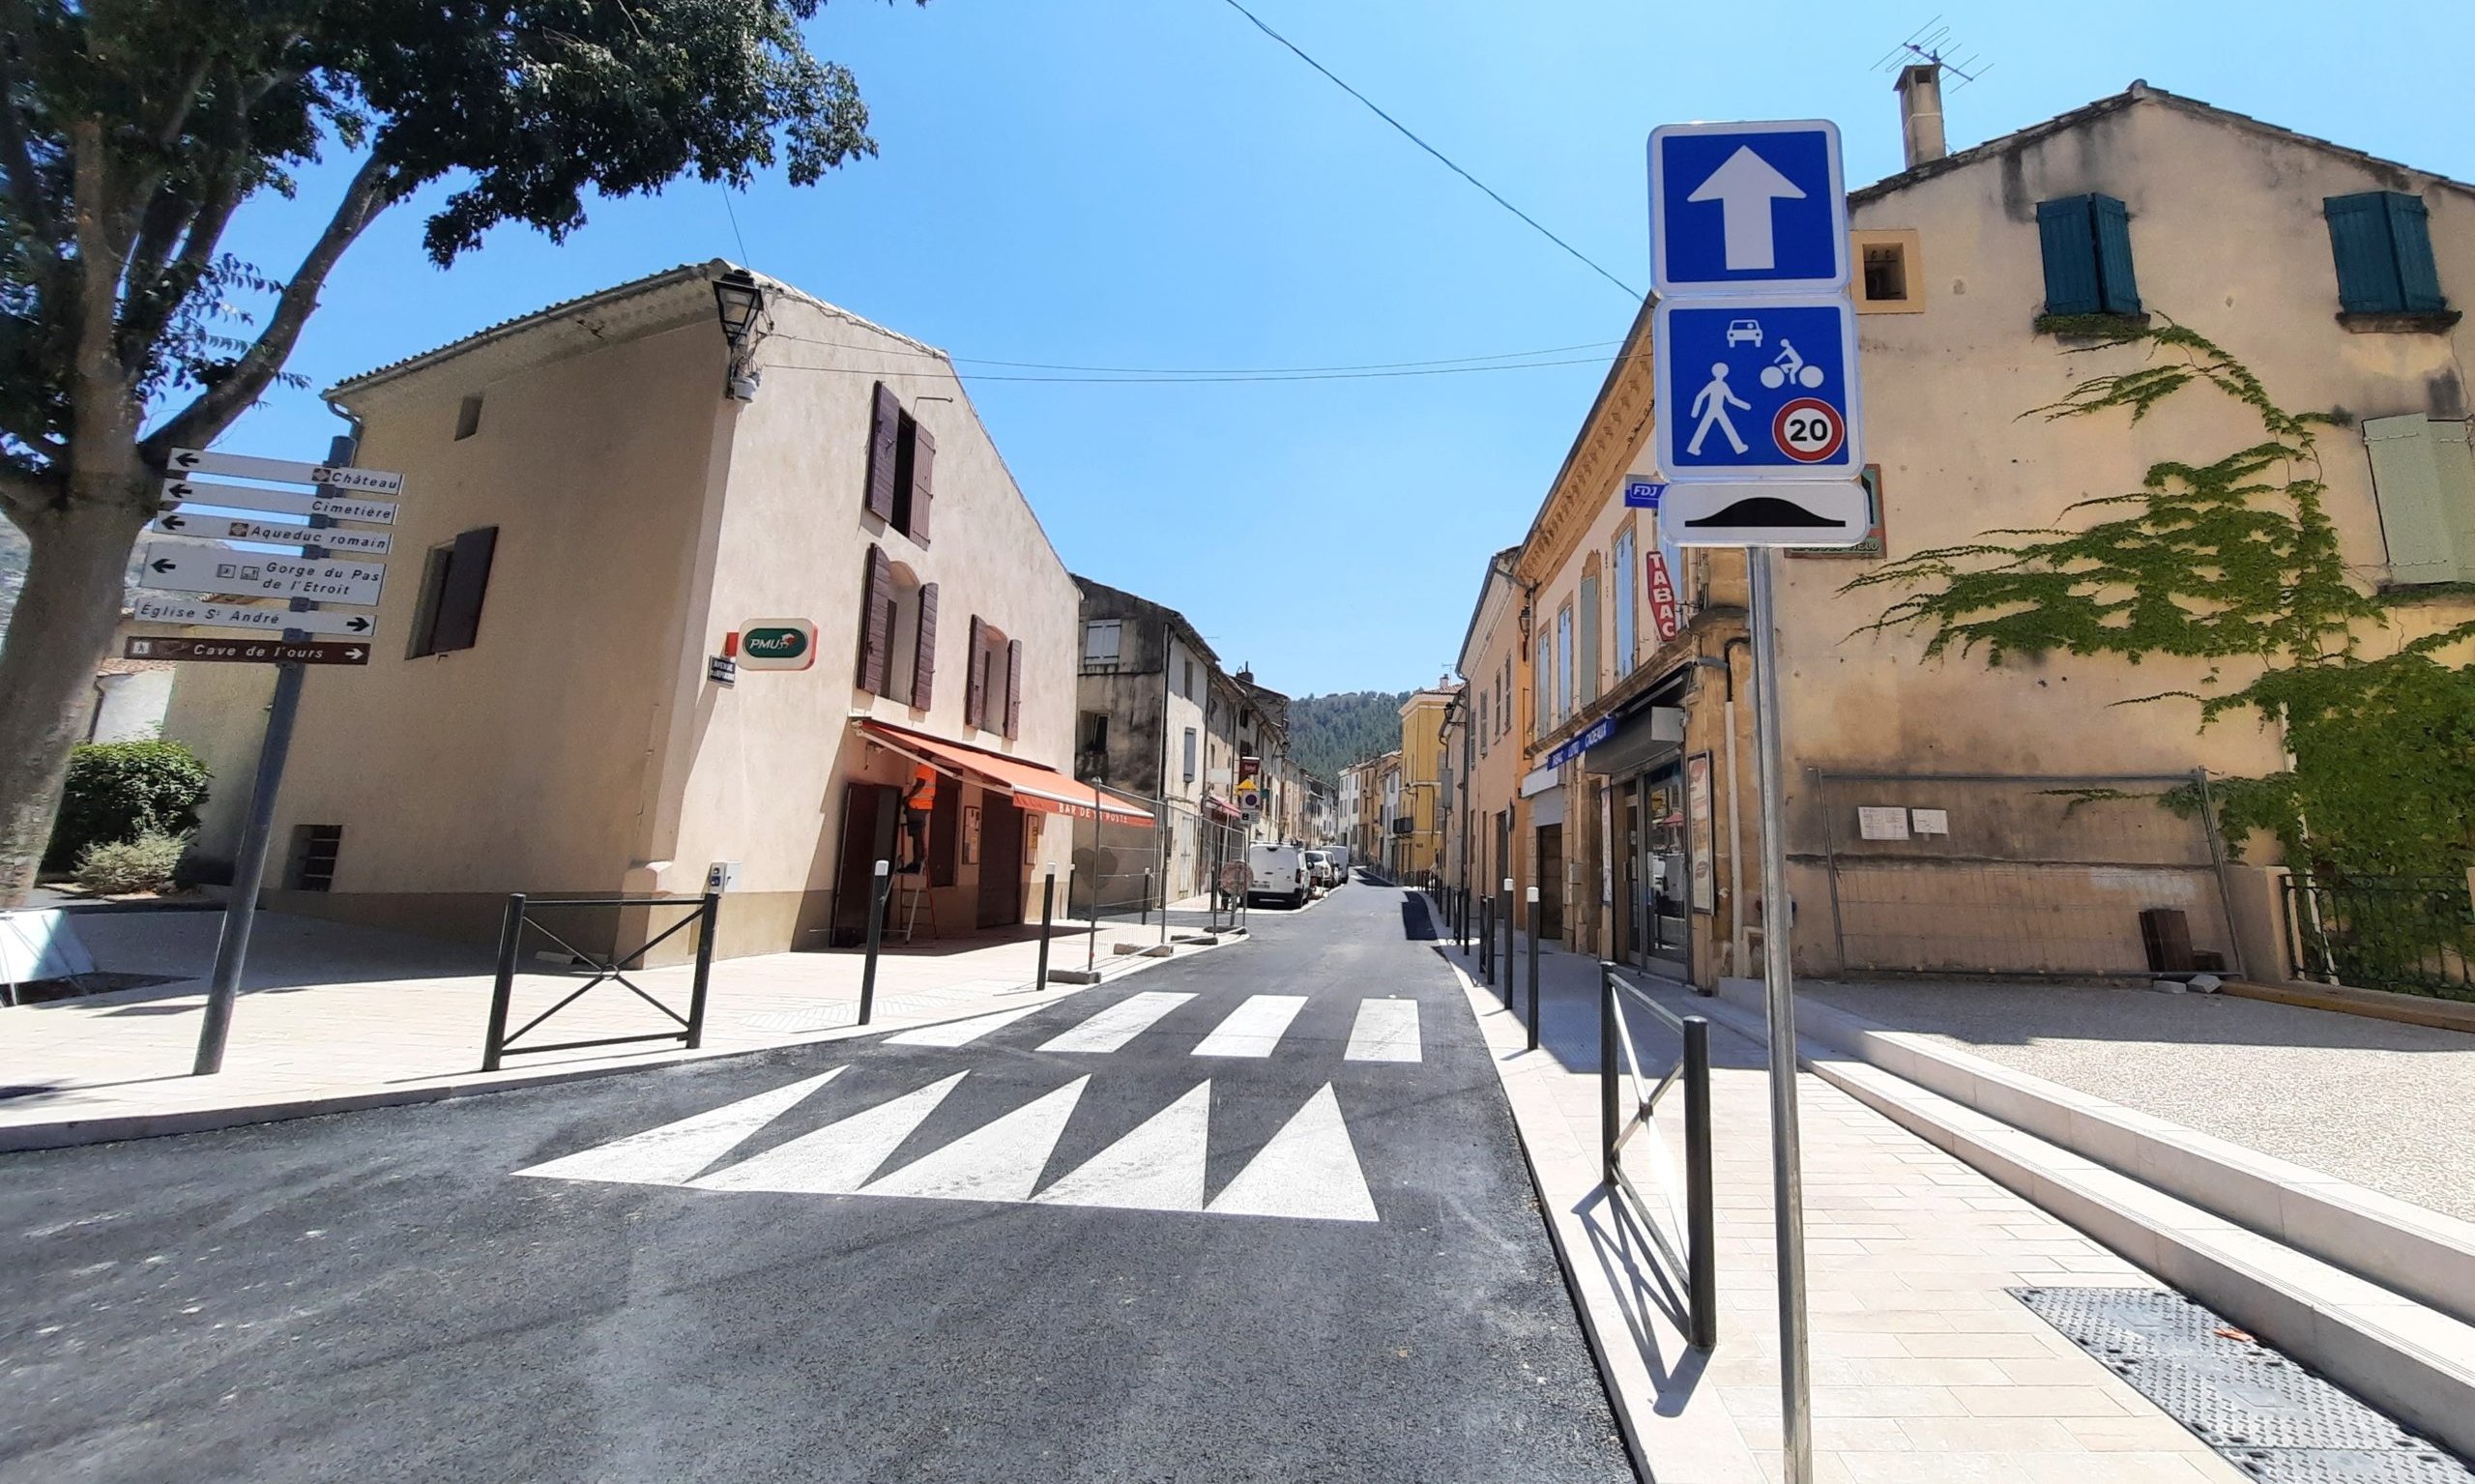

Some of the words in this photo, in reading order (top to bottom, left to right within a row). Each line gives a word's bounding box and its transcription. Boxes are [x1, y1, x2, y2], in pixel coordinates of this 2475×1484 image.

[1790, 419, 1828, 442] 20
[332, 472, 397, 489] Château
[1634, 485, 1658, 497] FDJ
[311, 500, 392, 519] Cimetière
[250, 526, 322, 542] Aqueduc
[330, 534, 388, 549] romain
[266, 561, 315, 578] Gorge
[324, 565, 343, 579] du
[351, 568, 380, 582] Pas
[262, 577, 281, 591] de
[290, 581, 350, 596] l'Etroit
[1649, 553, 1675, 638] TABAC
[229, 611, 279, 625] André
[192, 643, 236, 656] Cave
[246, 645, 265, 657] de
[274, 646, 324, 659] l'ours
[749, 638, 779, 650] PMU
[1059, 802, 1076, 816] BAR
[1080, 807, 1091, 818] DE
[1106, 812, 1128, 824] POSTE
